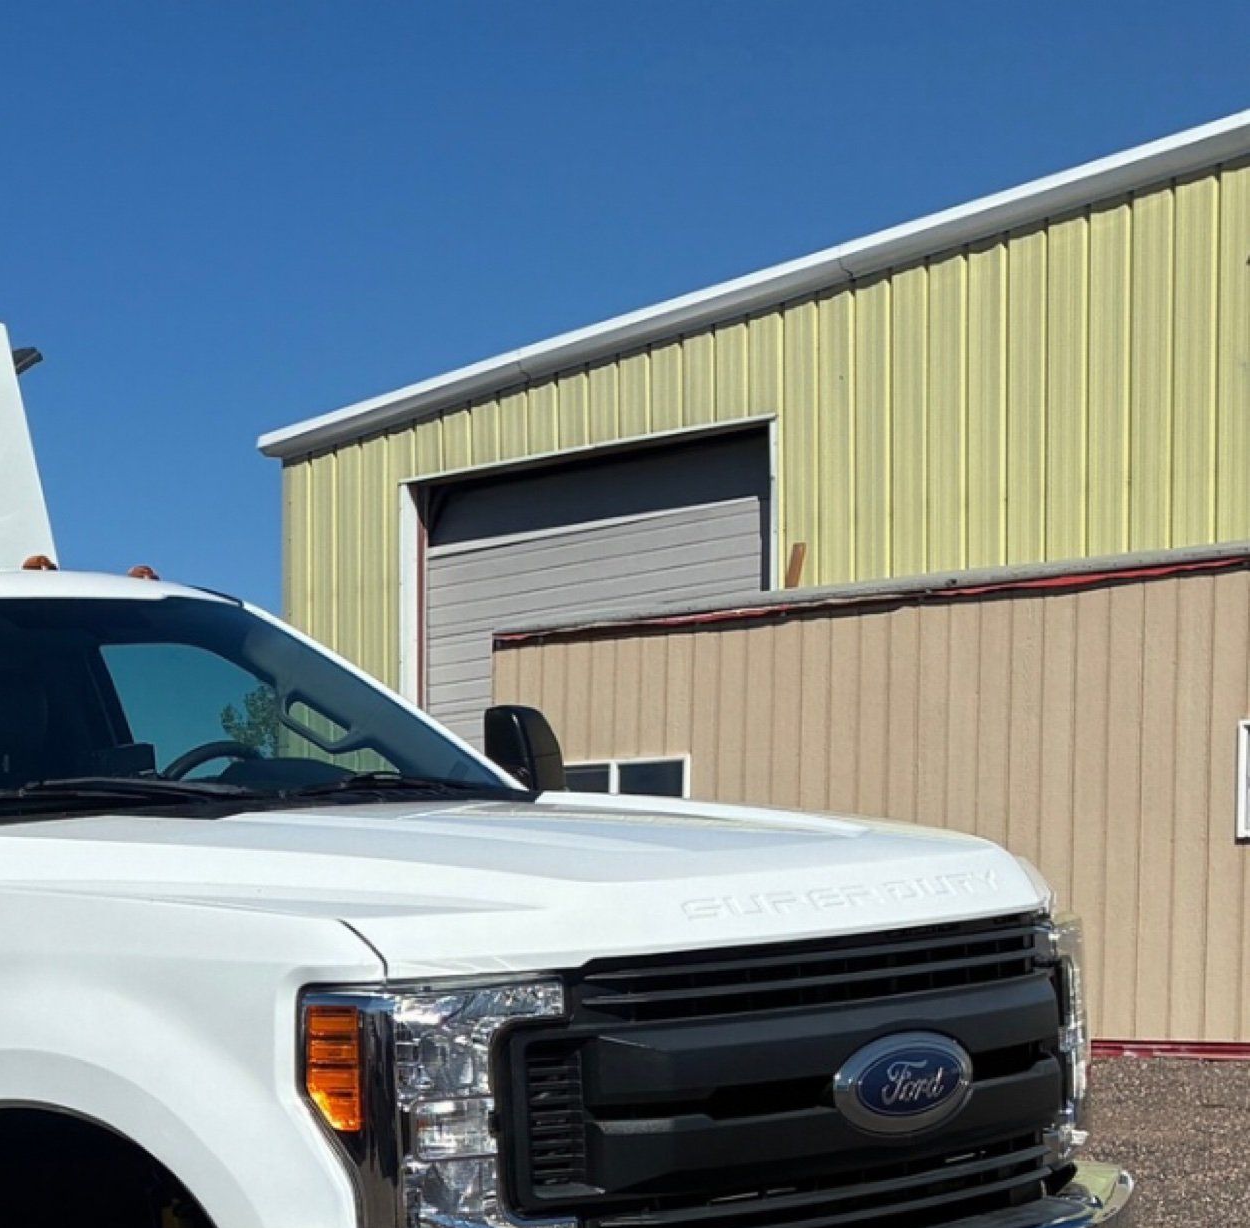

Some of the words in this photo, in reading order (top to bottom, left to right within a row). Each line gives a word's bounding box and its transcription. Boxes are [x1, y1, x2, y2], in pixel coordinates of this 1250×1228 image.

[683, 886, 880, 921] SUPER
[883, 869, 999, 904] DUTY
[880, 1059, 945, 1106] Ford
